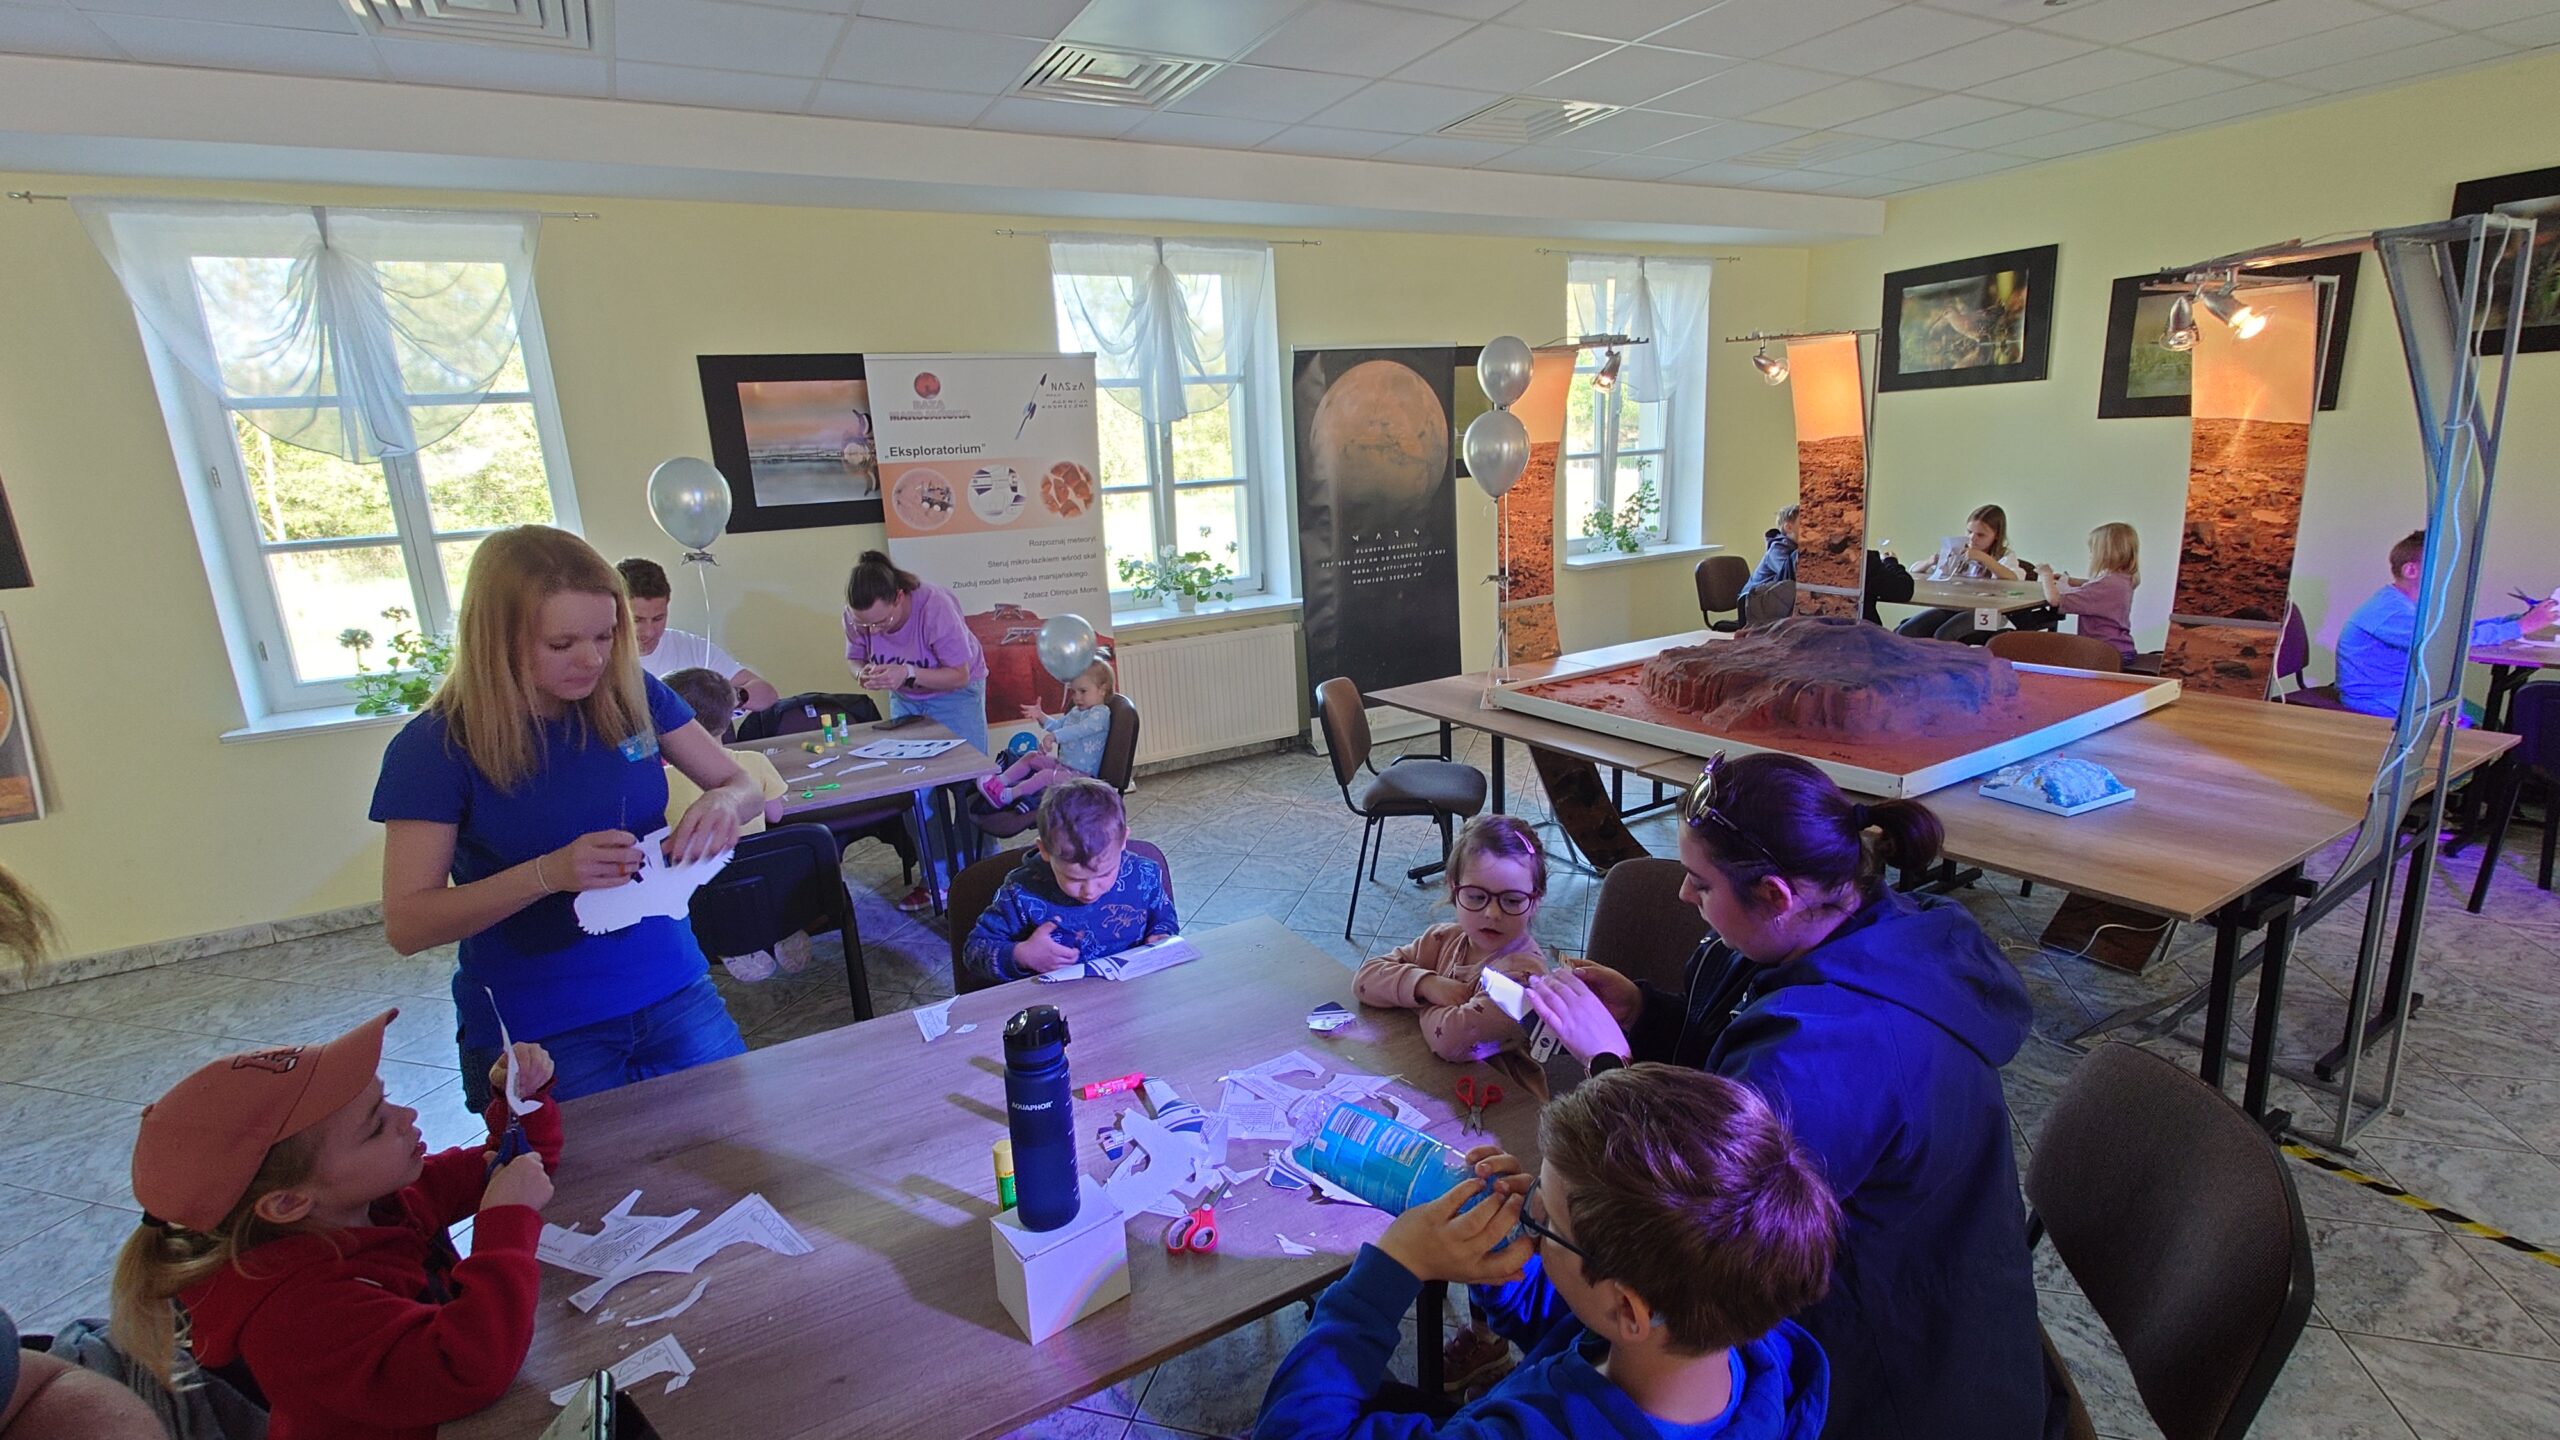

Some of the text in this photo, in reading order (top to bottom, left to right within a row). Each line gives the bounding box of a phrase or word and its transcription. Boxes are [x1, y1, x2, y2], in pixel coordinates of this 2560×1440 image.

[979, 577, 1001, 586] model
[1023, 590, 1049, 600] Zobacz
[1979, 614, 1989, 625] 3
